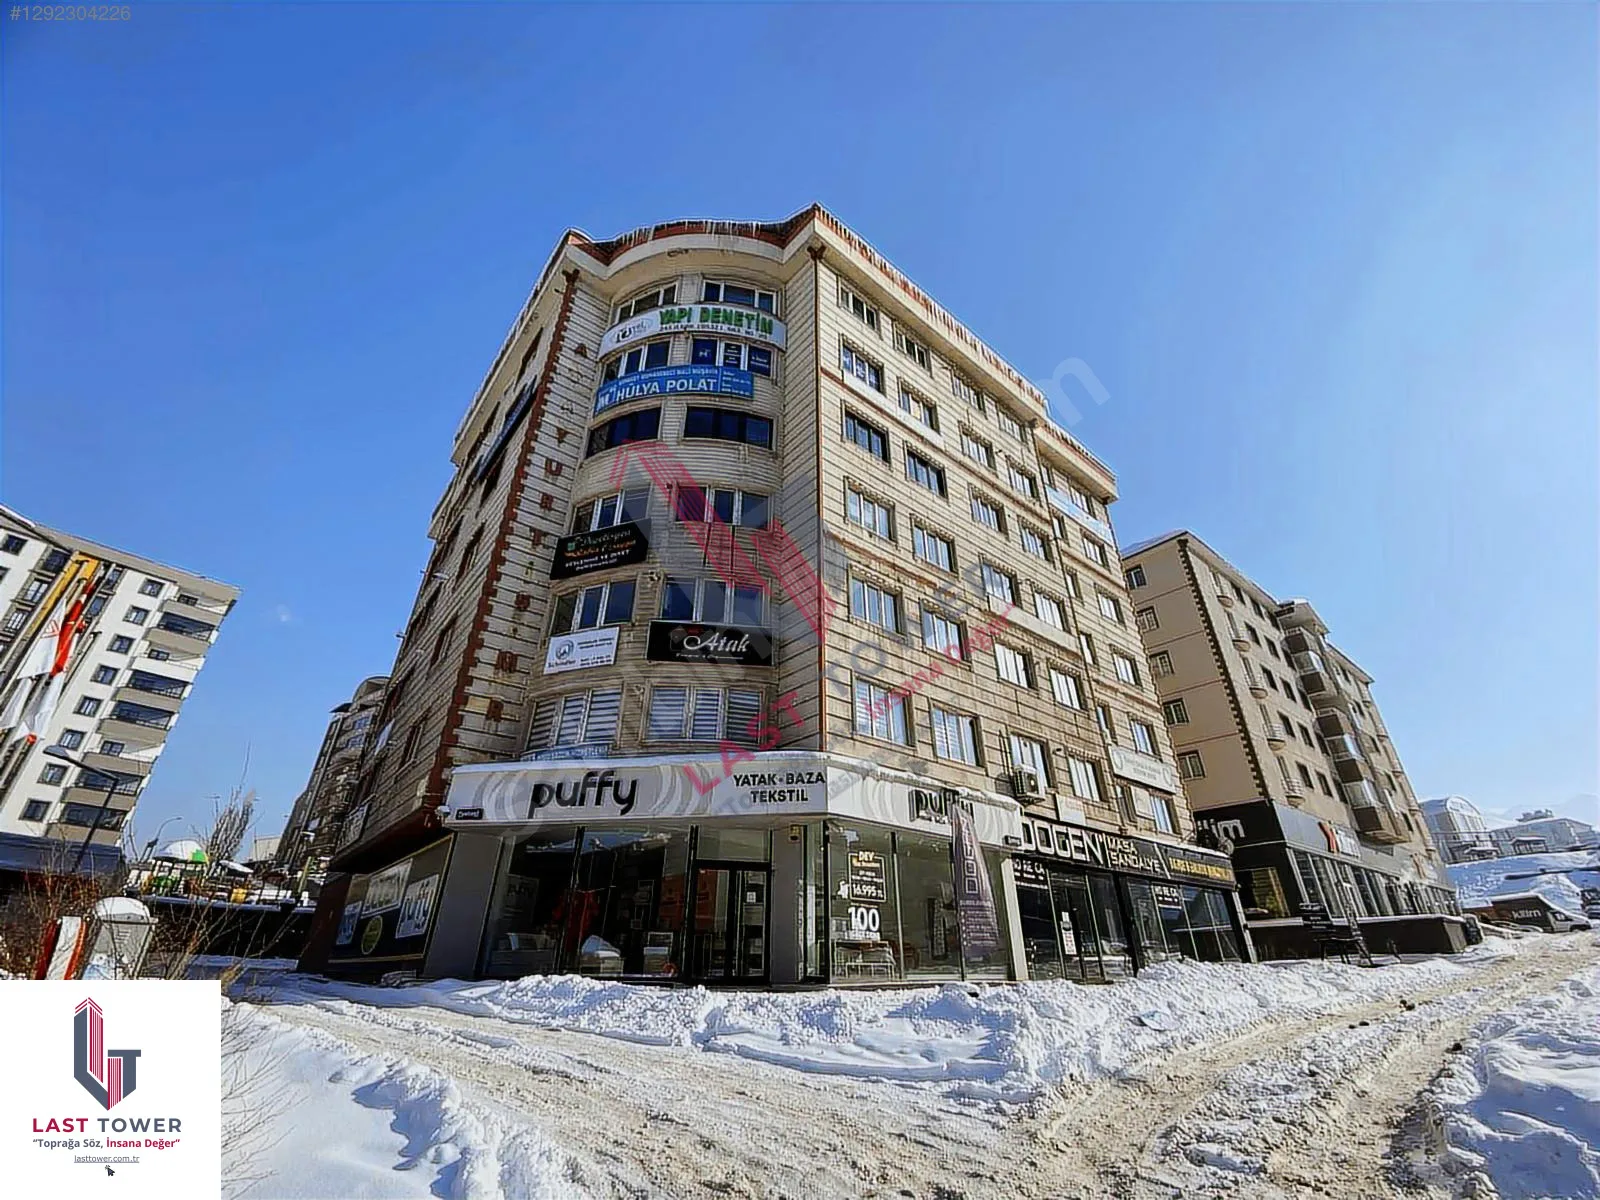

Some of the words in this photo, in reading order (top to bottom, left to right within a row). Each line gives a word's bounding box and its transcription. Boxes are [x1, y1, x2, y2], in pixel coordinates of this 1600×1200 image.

[659, 307, 692, 325] YAPI
[616, 378, 660, 401] HÜLYA
[665, 378, 718, 393] POLAT
[733, 773, 776, 786] YATAK
[785, 771, 826, 785] BAZA
[527, 769, 638, 819] puffy
[750, 788, 809, 803] TEKSTİL
[1108, 837, 1138, 854] MASA
[1111, 853, 1161, 873] SANDALYE
[848, 906, 880, 932] 100
